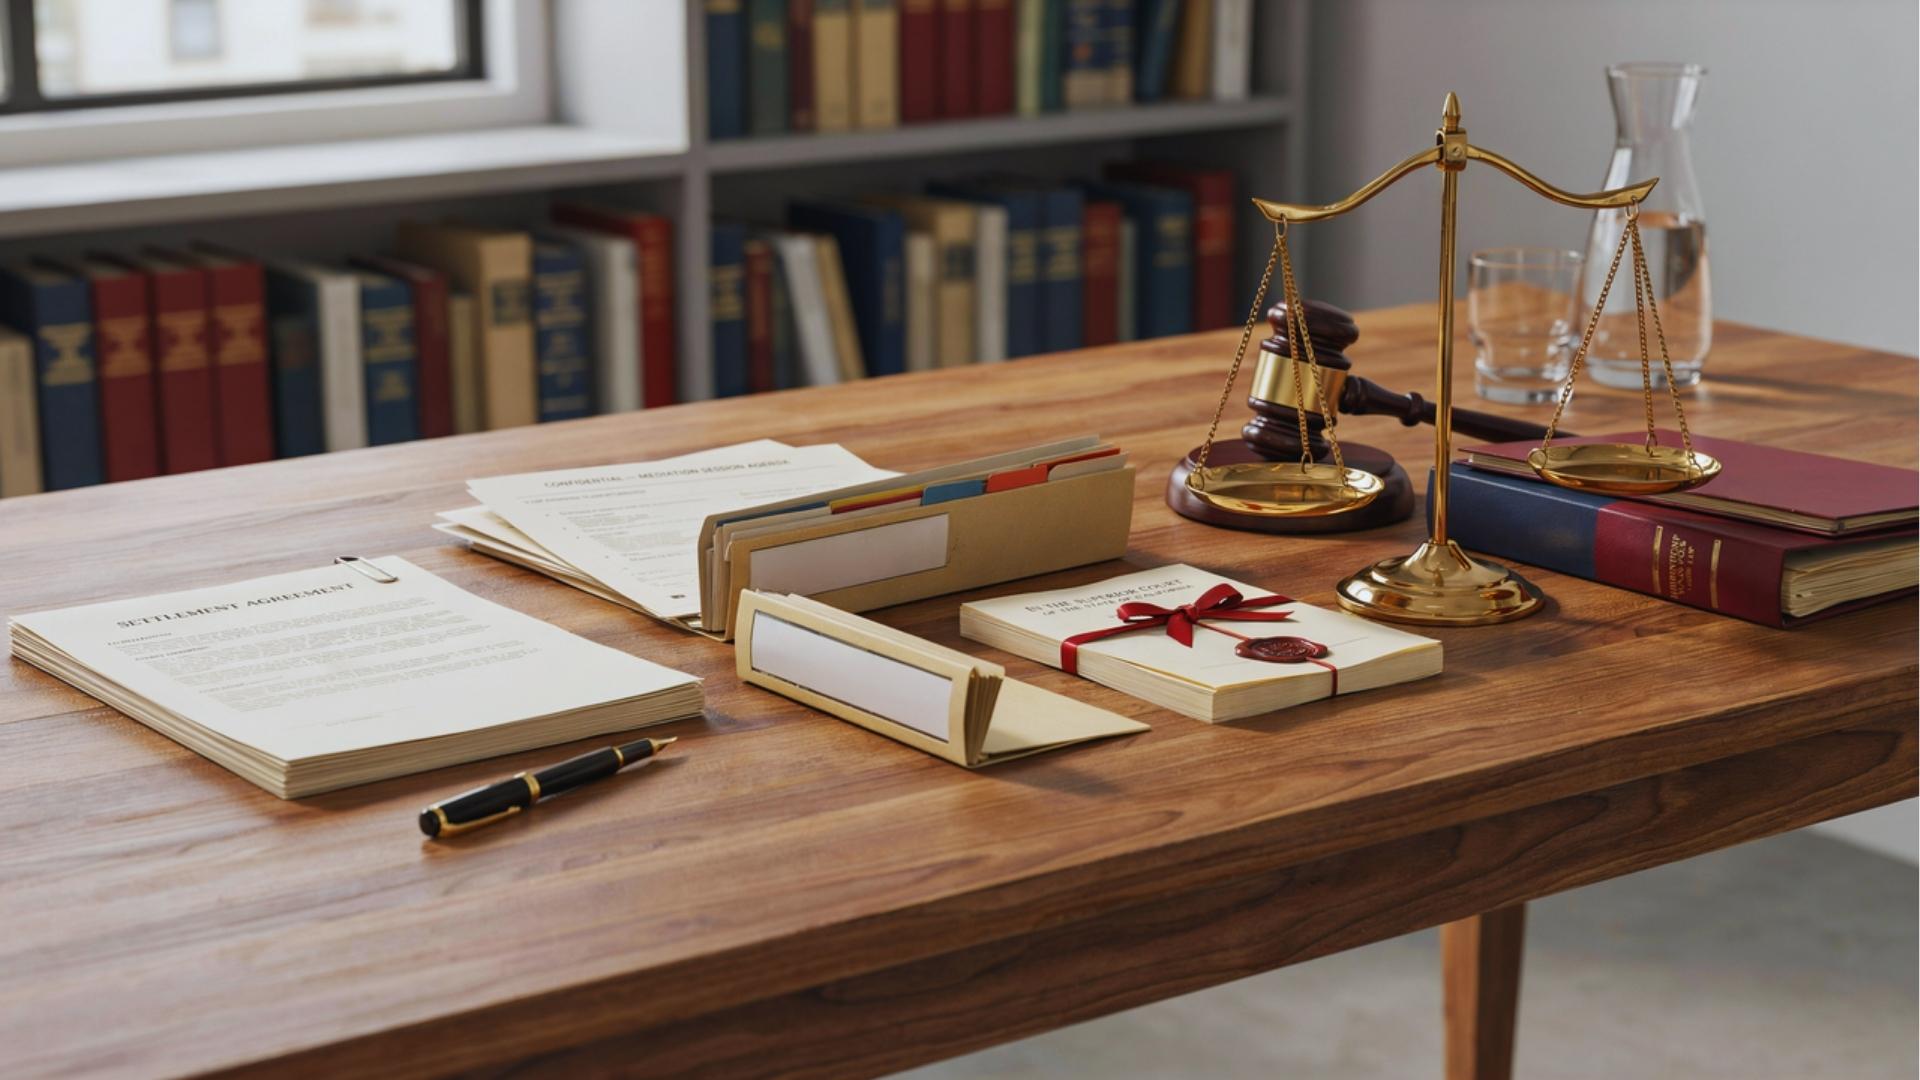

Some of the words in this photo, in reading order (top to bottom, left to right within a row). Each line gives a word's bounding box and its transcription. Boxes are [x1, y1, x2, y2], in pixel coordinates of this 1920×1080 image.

[701, 463, 745, 474] SESSION
[116, 602, 240, 630] SETTLEMENT
[247, 582, 354, 607] AGREEMENT
[1044, 600, 1072, 609] THE
[1075, 588, 1137, 604] SUPERIOR
[1138, 579, 1183, 592] COURT
